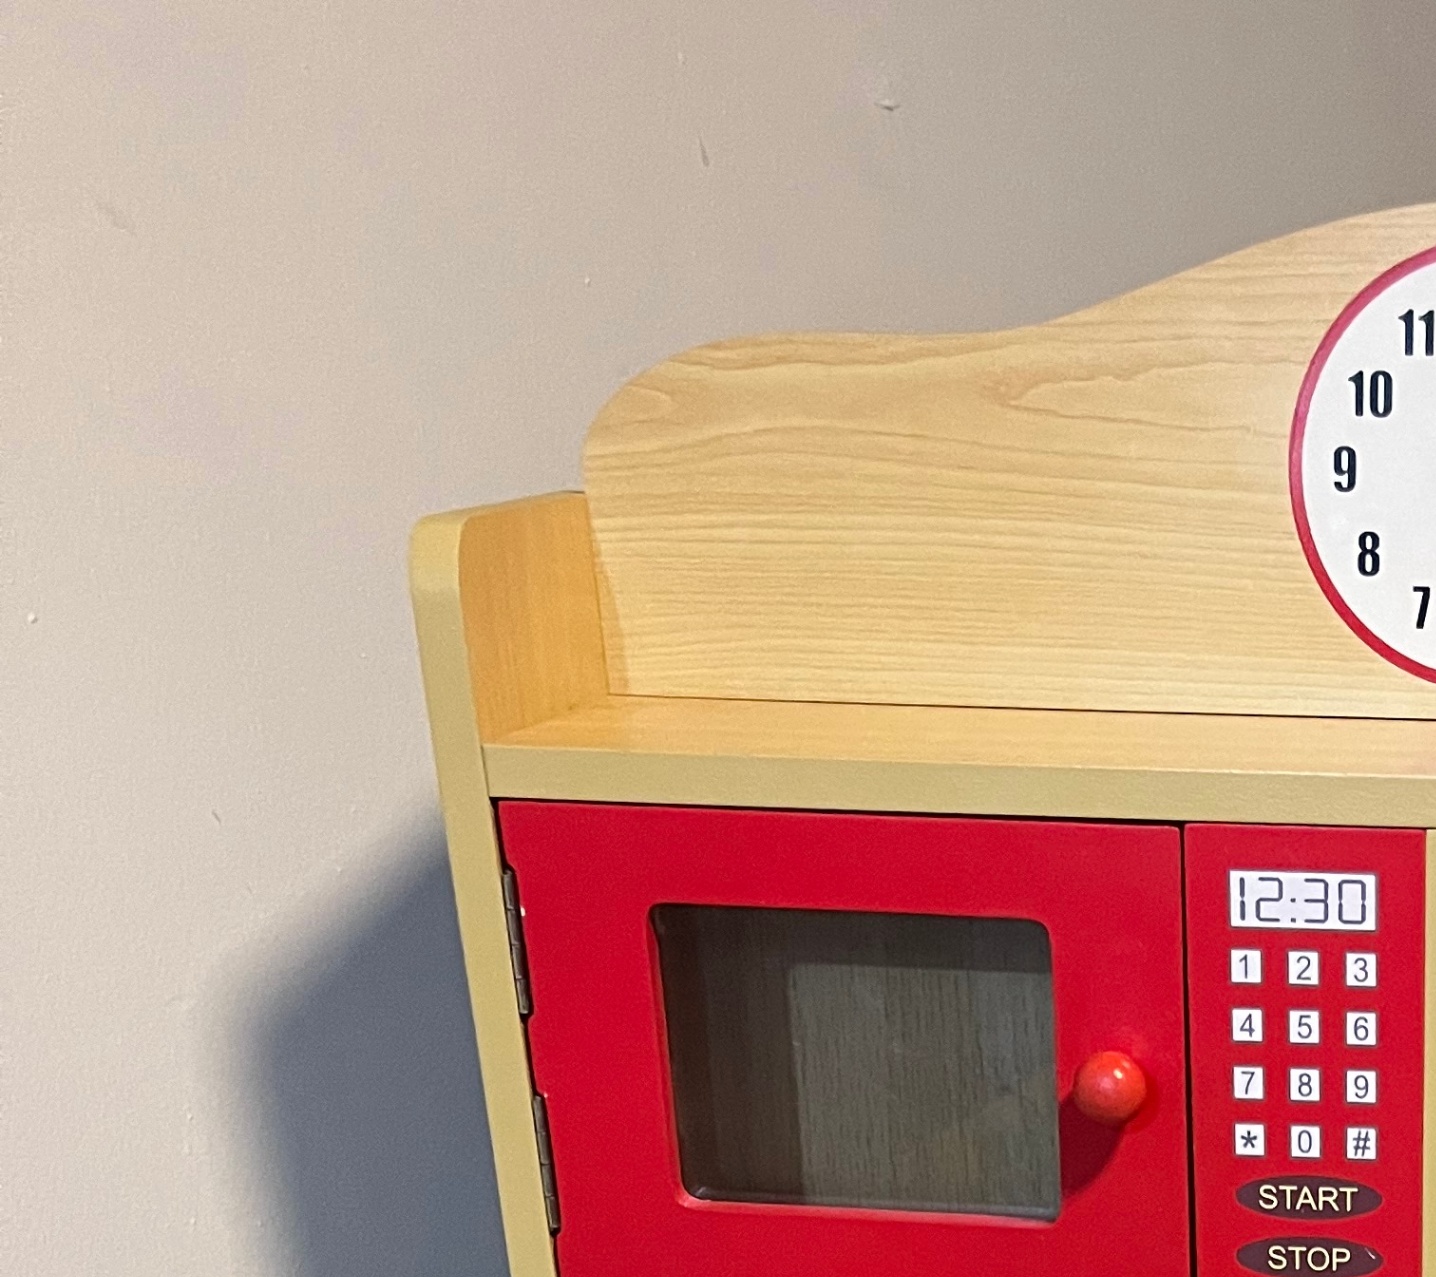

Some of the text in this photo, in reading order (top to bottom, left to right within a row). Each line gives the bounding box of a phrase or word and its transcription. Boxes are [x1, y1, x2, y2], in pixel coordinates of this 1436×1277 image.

[1398, 308, 1435, 356] 11
[1348, 370, 1393, 418] 10
[1333, 445, 1357, 493] 9
[1357, 531, 1380, 577] 8
[1412, 586, 1431, 630] 7
[1239, 876, 1367, 924] 12:30
[1238, 954, 1369, 983] 1 2 3
[1239, 1013, 1369, 1041] 4 5 6
[1241, 1070, 1369, 1099] 7 8 9
[1297, 1128, 1313, 1154] 0
[1258, 1184, 1359, 1212] START
[1267, 1245, 1351, 1272] STOP
